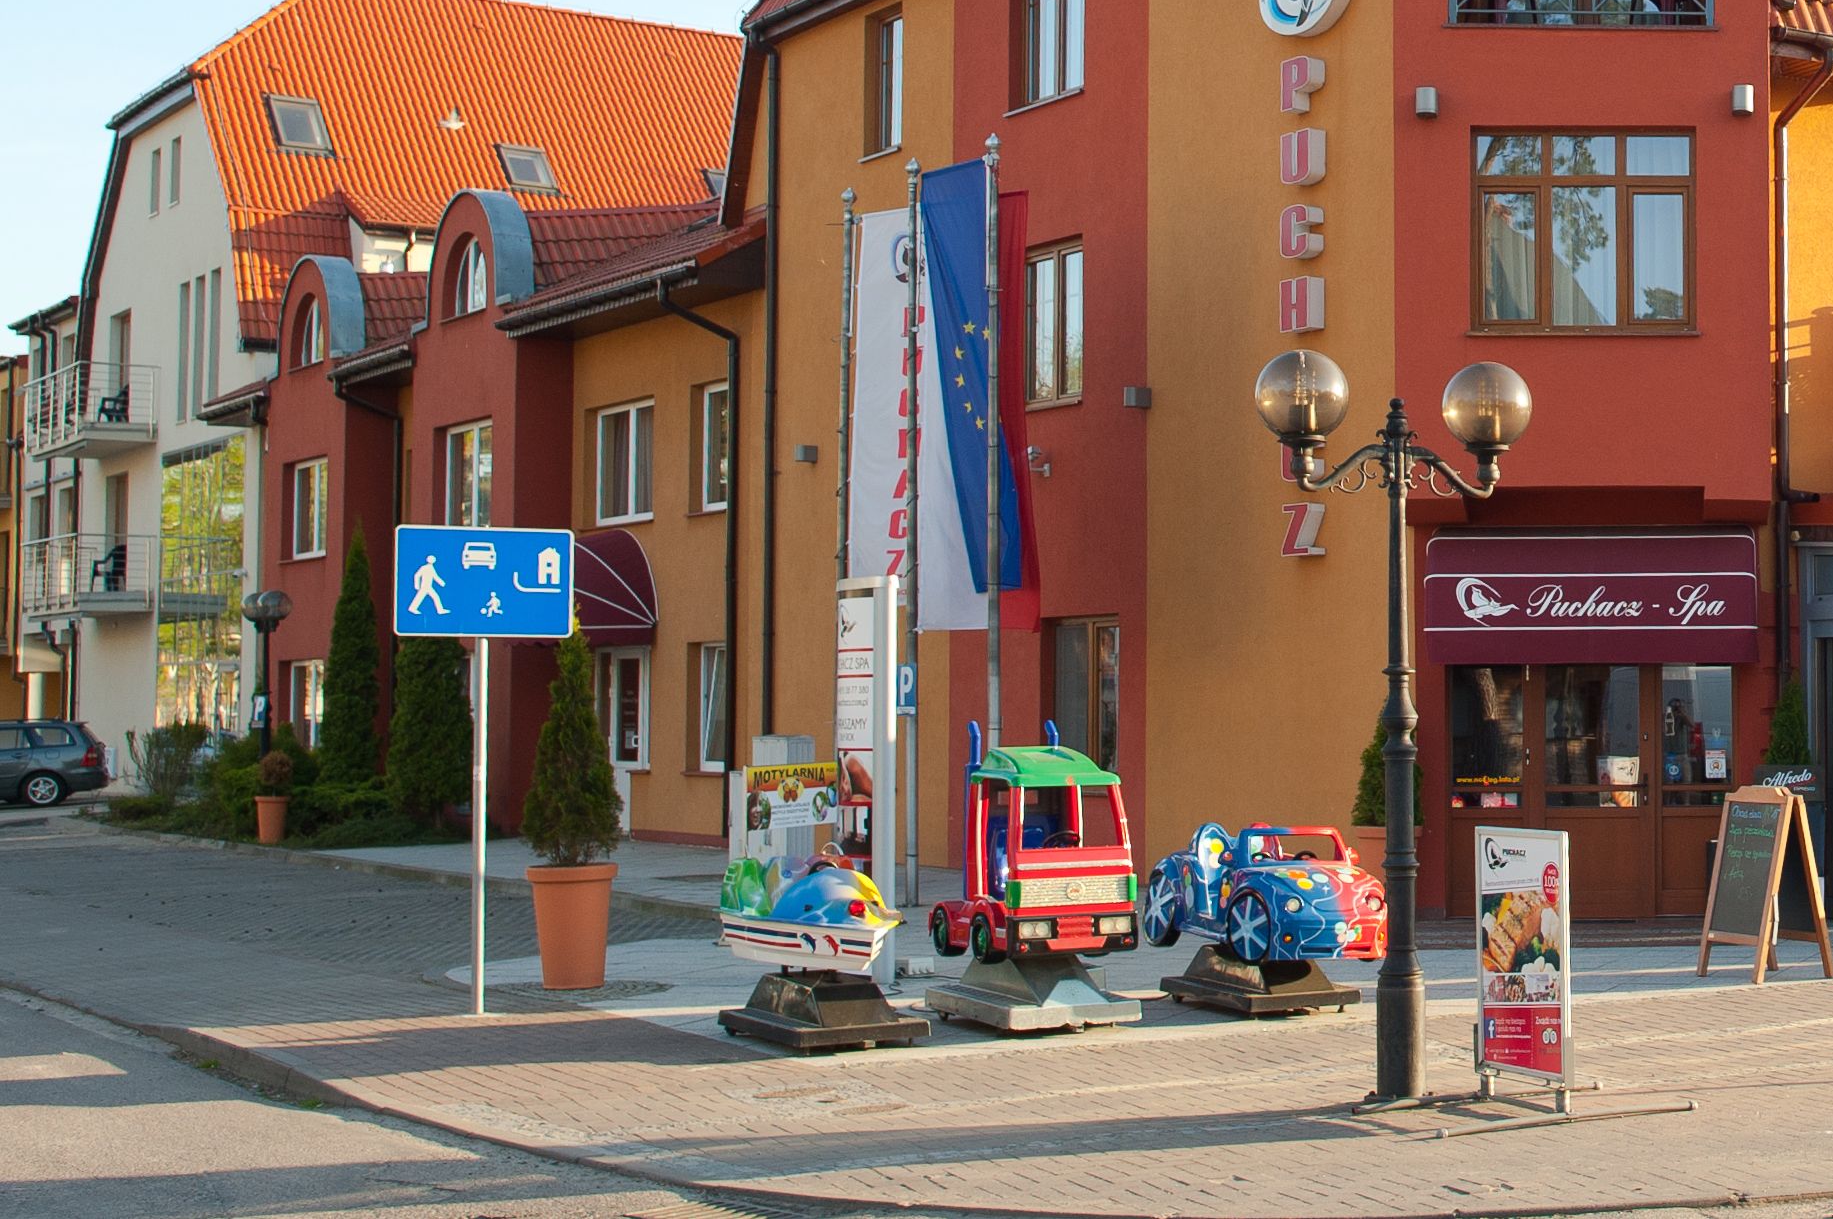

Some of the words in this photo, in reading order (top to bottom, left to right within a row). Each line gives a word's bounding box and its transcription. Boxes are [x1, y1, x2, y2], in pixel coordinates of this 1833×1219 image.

[1279, 56, 1326, 557] PUCHCZ
[1526, 584, 1644, 618] Puchacz
[1668, 583, 1726, 625] Spa
[900, 666, 914, 706] P
[753, 767, 825, 789] MOTYLARNIA
[1763, 769, 1812, 787] Alfredo
